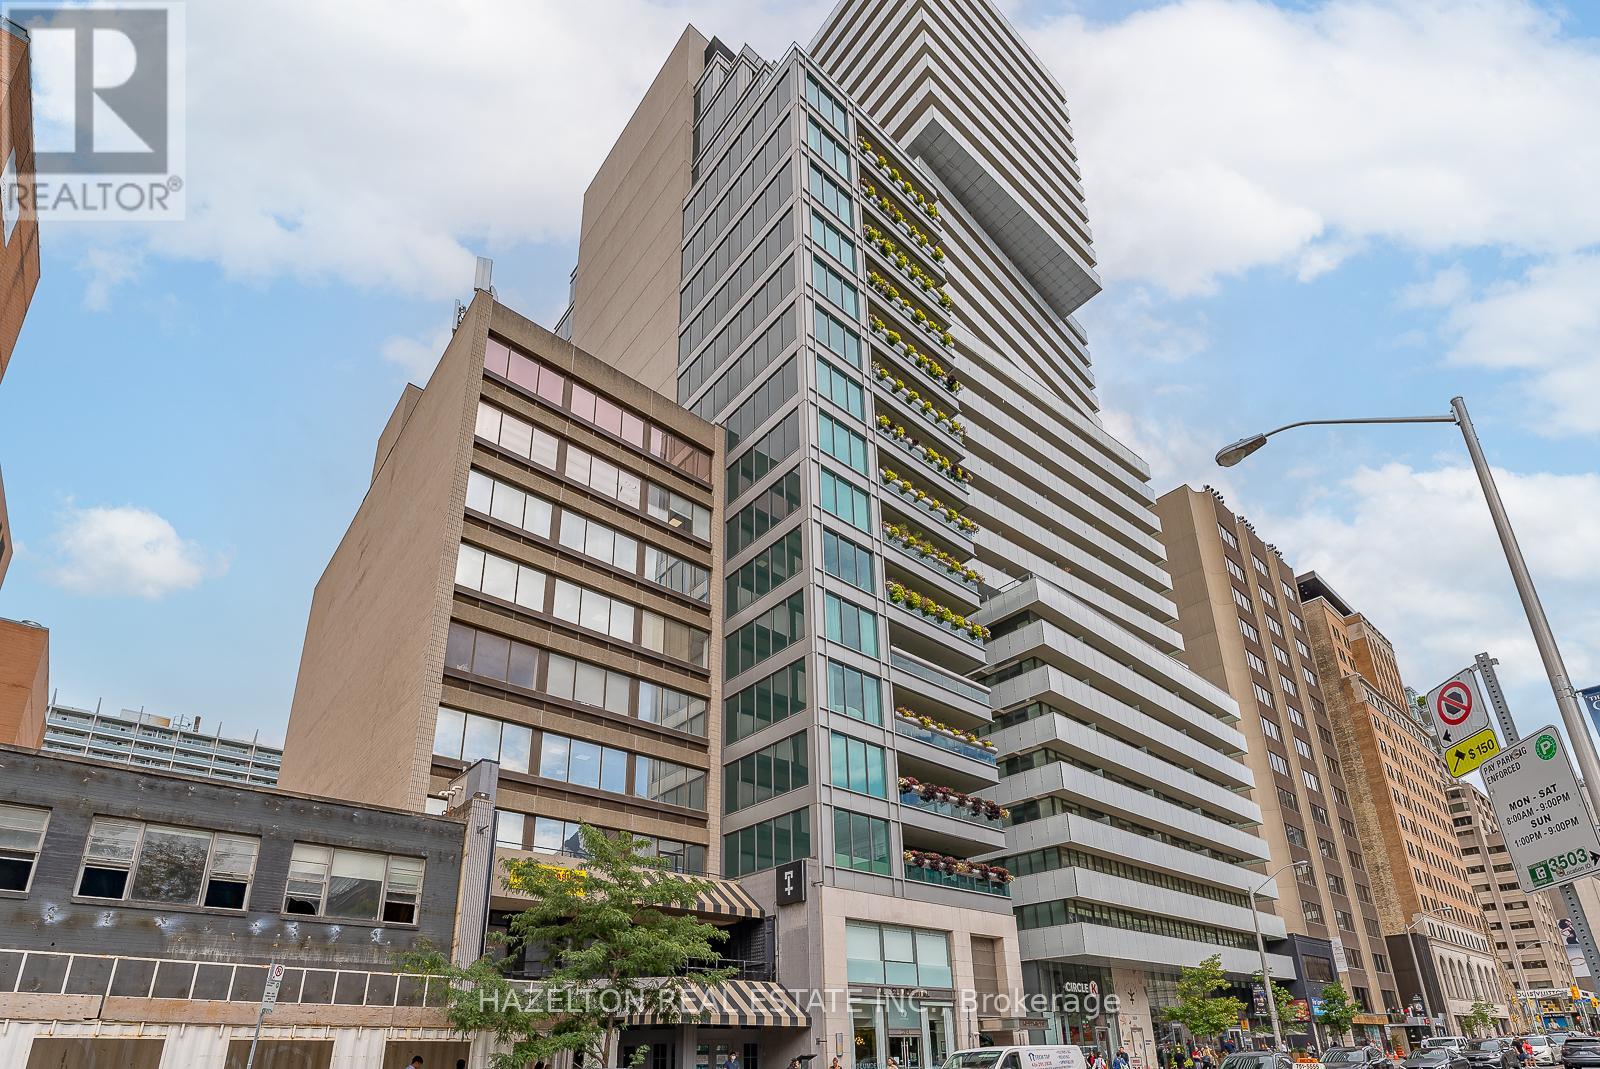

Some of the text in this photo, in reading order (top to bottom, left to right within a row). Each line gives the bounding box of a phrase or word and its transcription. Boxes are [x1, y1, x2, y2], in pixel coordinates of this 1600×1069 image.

[1483, 747, 1527, 775] PAY PARKNG
[1486, 763, 1521, 785] ENFORCED
[1506, 807, 1534, 826] 8:00AM
[1540, 792, 1571, 811] 9:00PM
[1508, 796, 1531, 811] MON
[1538, 783, 1557, 798] SAT
[1514, 831, 1542, 847] 1:00PM
[1548, 816, 1579, 835] 9:00PM
[1530, 813, 1552, 828] SUN
[1549, 848, 1588, 872] 3503
[1065, 982, 1097, 995] CIRCLE K
